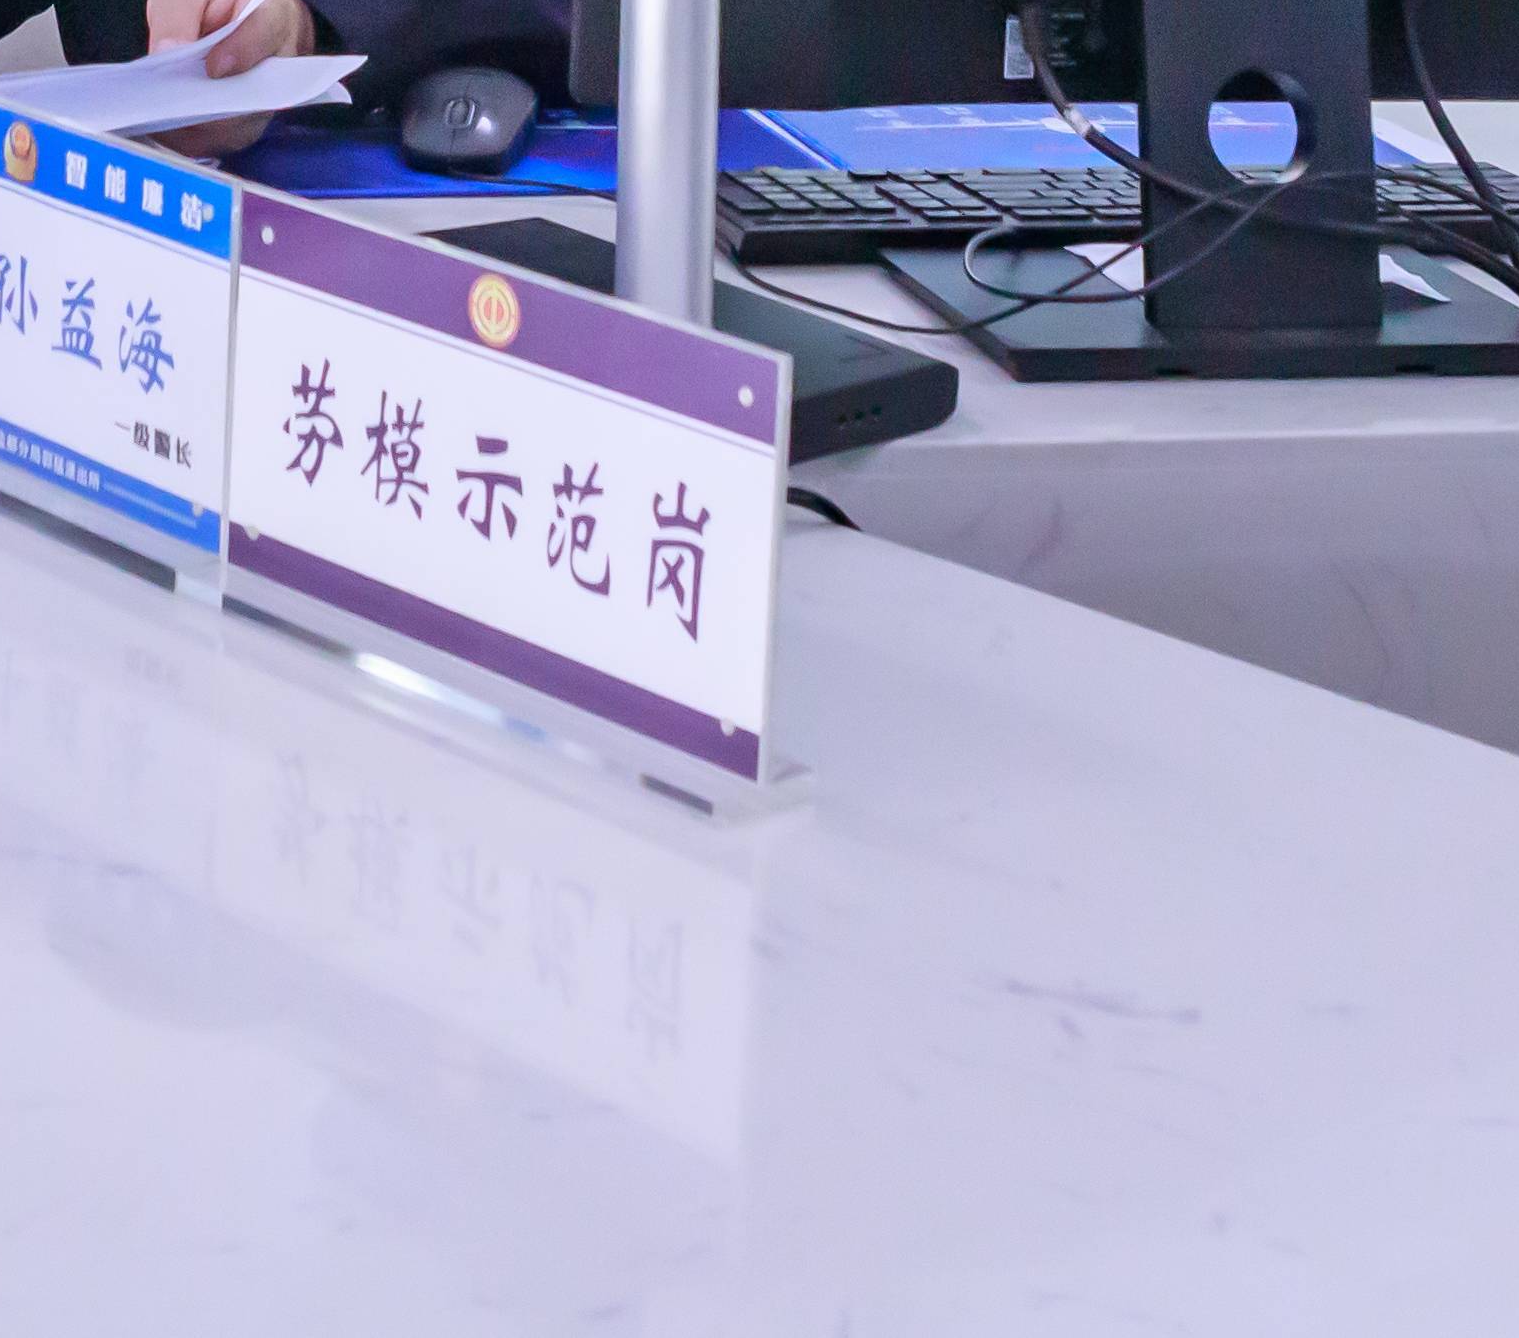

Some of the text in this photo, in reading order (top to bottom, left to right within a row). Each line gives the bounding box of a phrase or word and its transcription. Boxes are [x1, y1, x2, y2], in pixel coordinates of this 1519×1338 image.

[115, 420, 193, 470] 一级警长
[281, 358, 711, 642] 劳模示范岗
